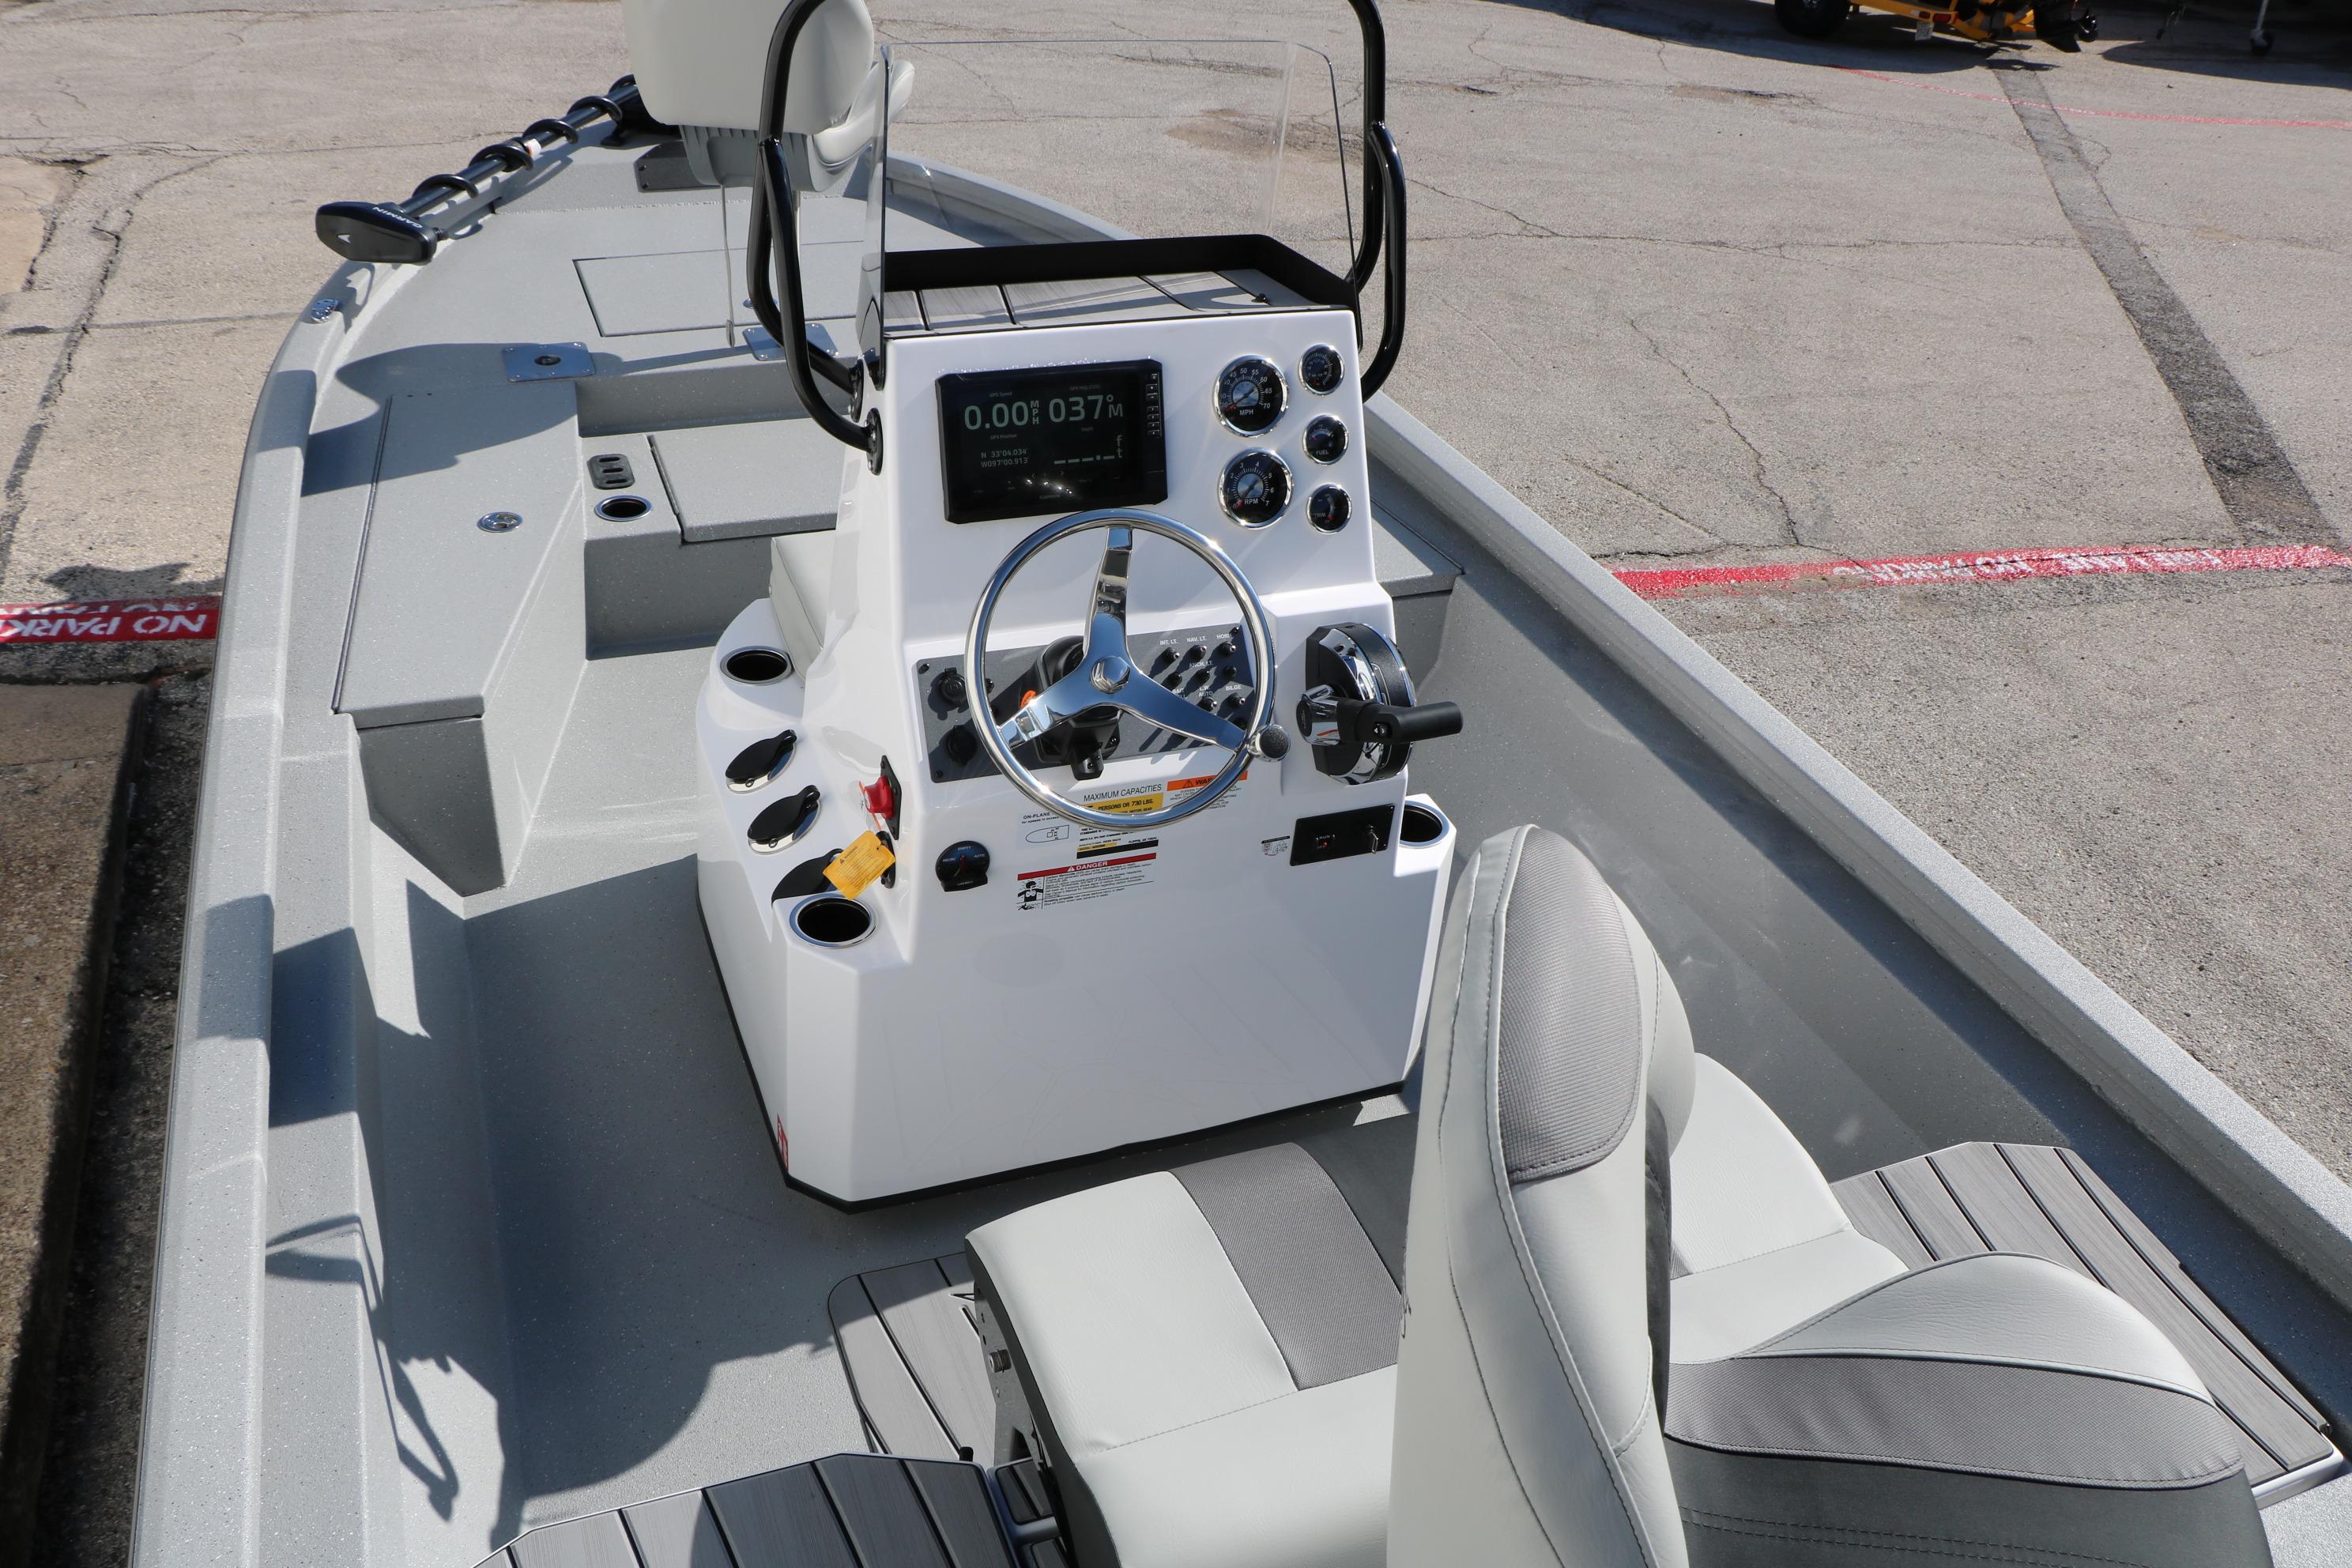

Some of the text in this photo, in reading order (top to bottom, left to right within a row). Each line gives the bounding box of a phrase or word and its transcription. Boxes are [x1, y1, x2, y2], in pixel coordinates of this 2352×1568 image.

[372, 206, 424, 228] GARMIN
[963, 401, 1029, 430] 0.00
[133, 614, 207, 634] NO
[1084, 784, 1162, 801] MAXIMUM CAPACITIES
[1076, 861, 1108, 870] DANGER
